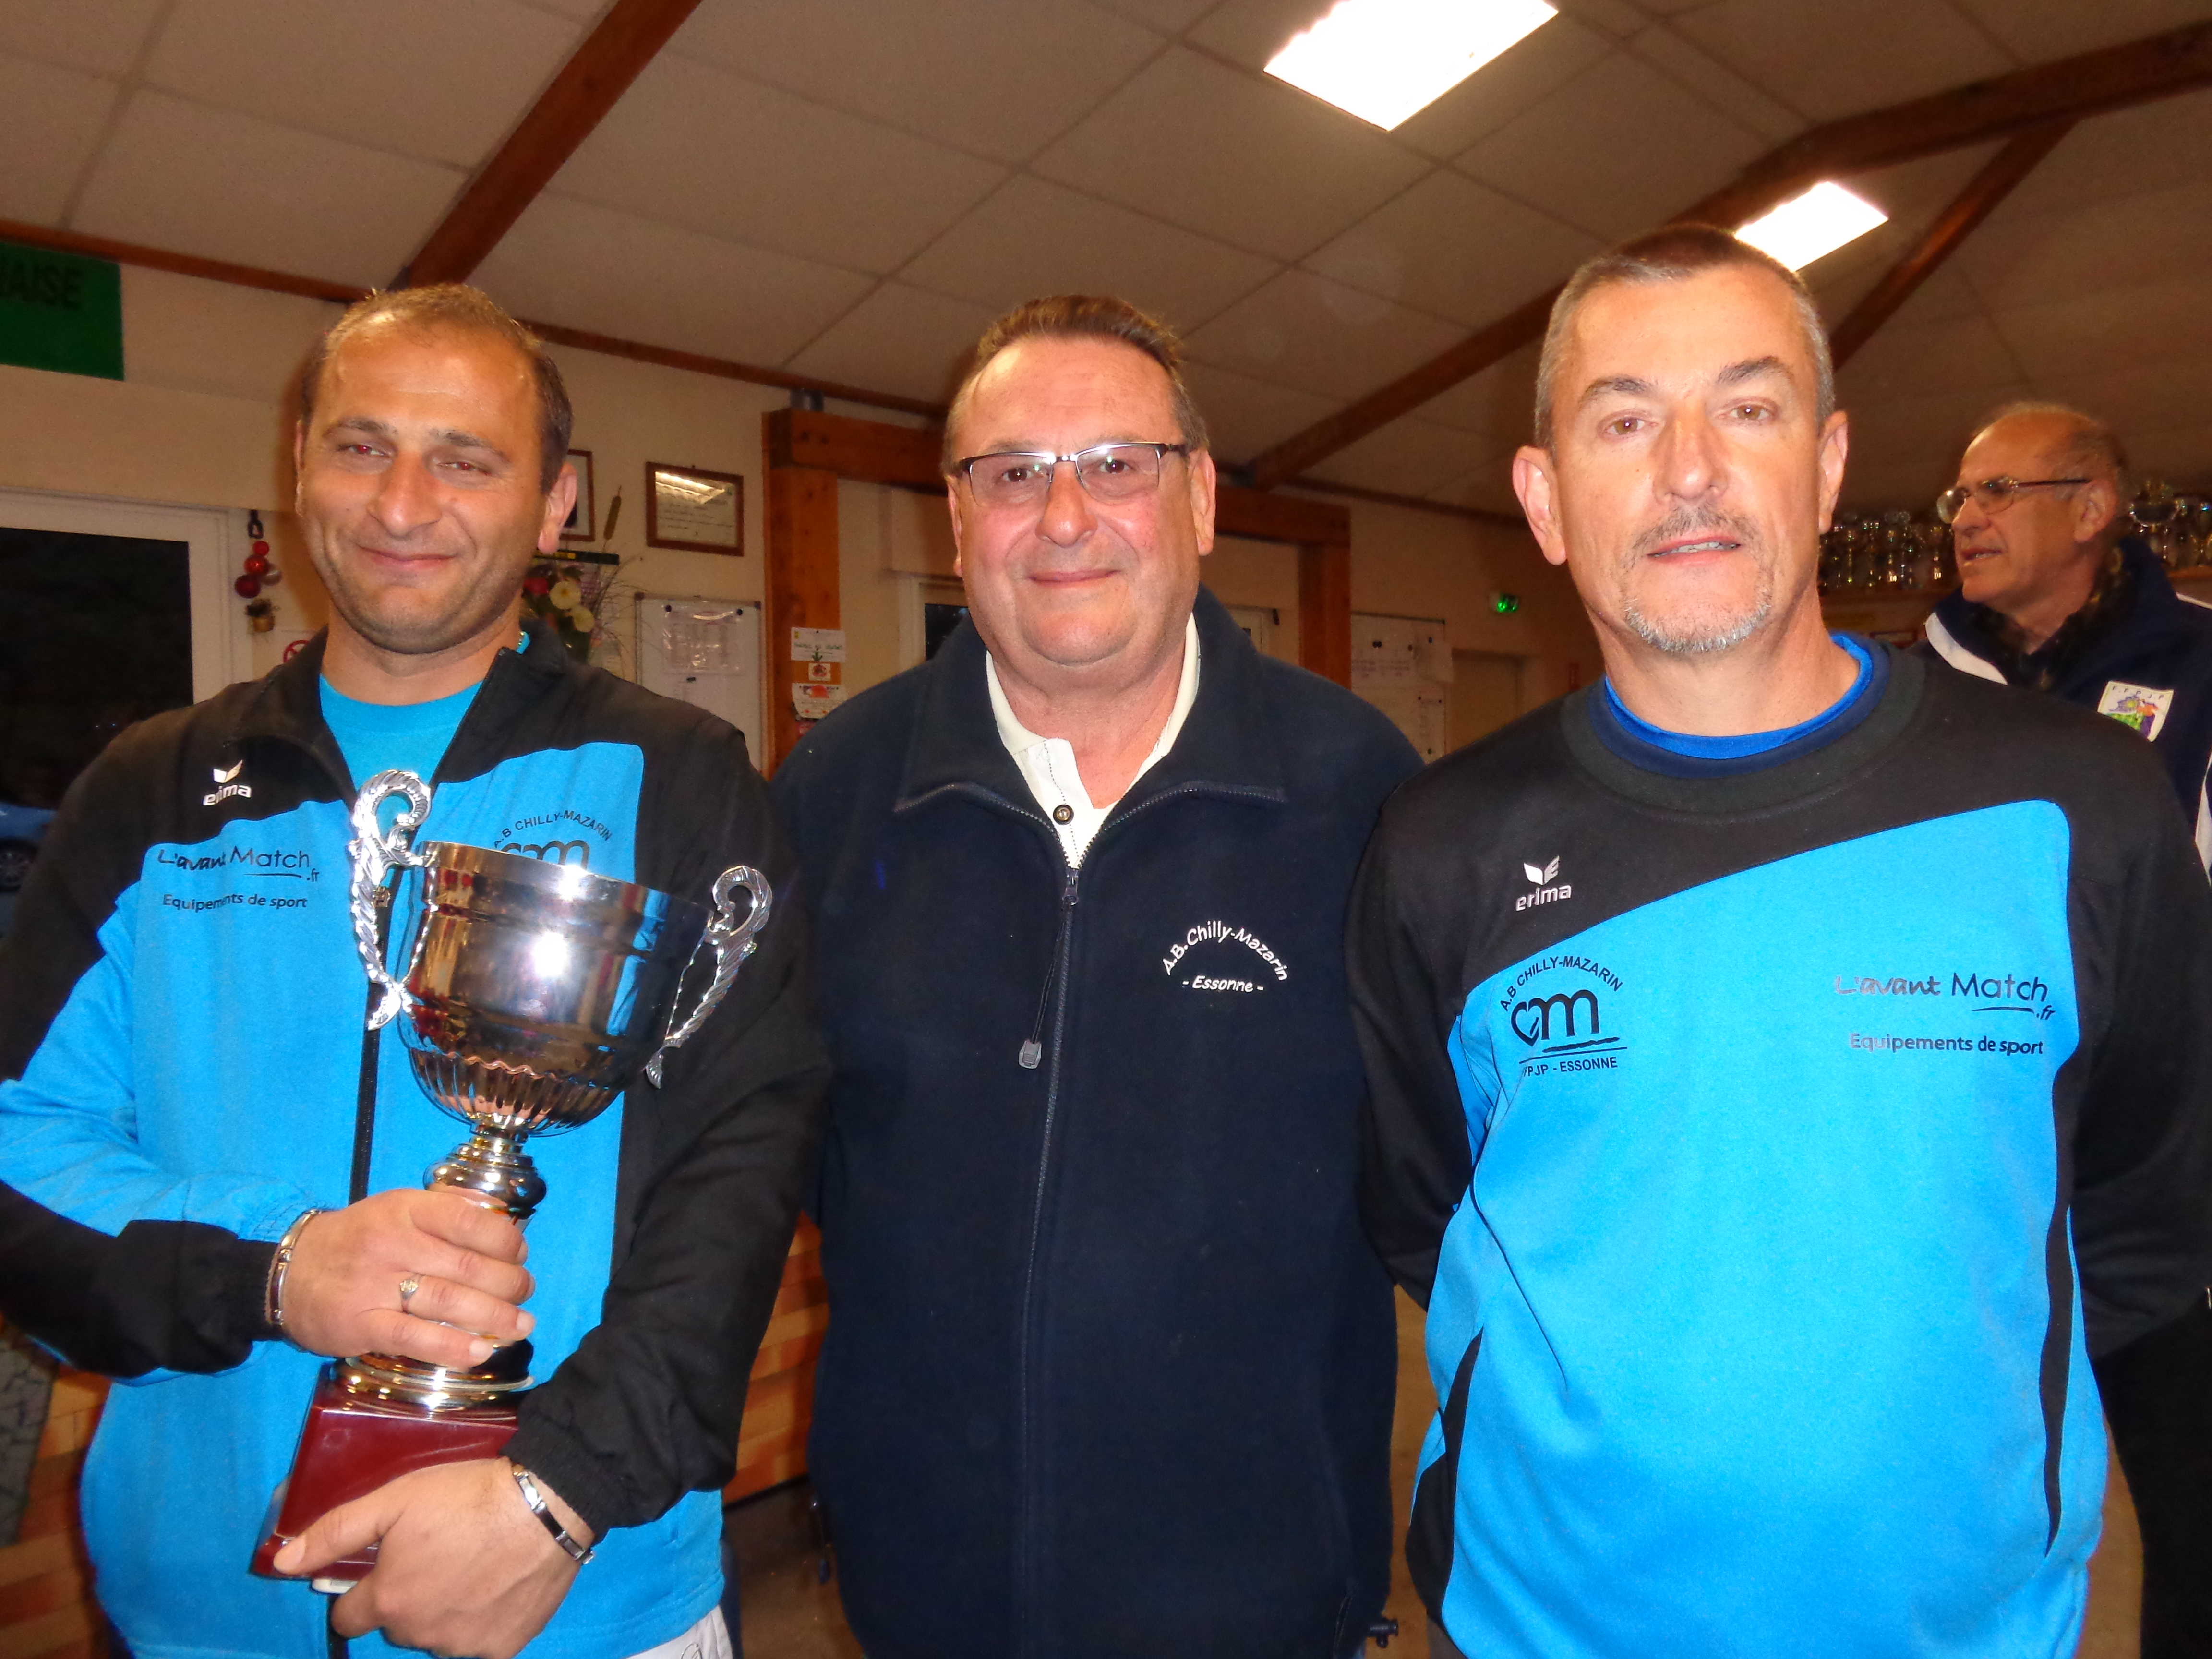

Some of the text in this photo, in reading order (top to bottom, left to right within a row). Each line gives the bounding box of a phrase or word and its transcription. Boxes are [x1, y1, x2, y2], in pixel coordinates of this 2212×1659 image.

[515, 810, 613, 841] CHILLY-MAZARIN
[230, 845, 310, 868] Match
[248, 893, 266, 906] de
[270, 898, 308, 910] sport
[1515, 885, 1571, 911] erima
[1500, 956, 1623, 1012] A.B CHILLY-MAZARIN
[1835, 975, 1941, 996] L'avant
[1951, 972, 2048, 1002] Match
[1850, 1033, 2044, 1056] Equipements de sport
[1560, 1057, 1618, 1072] ESSONNE
